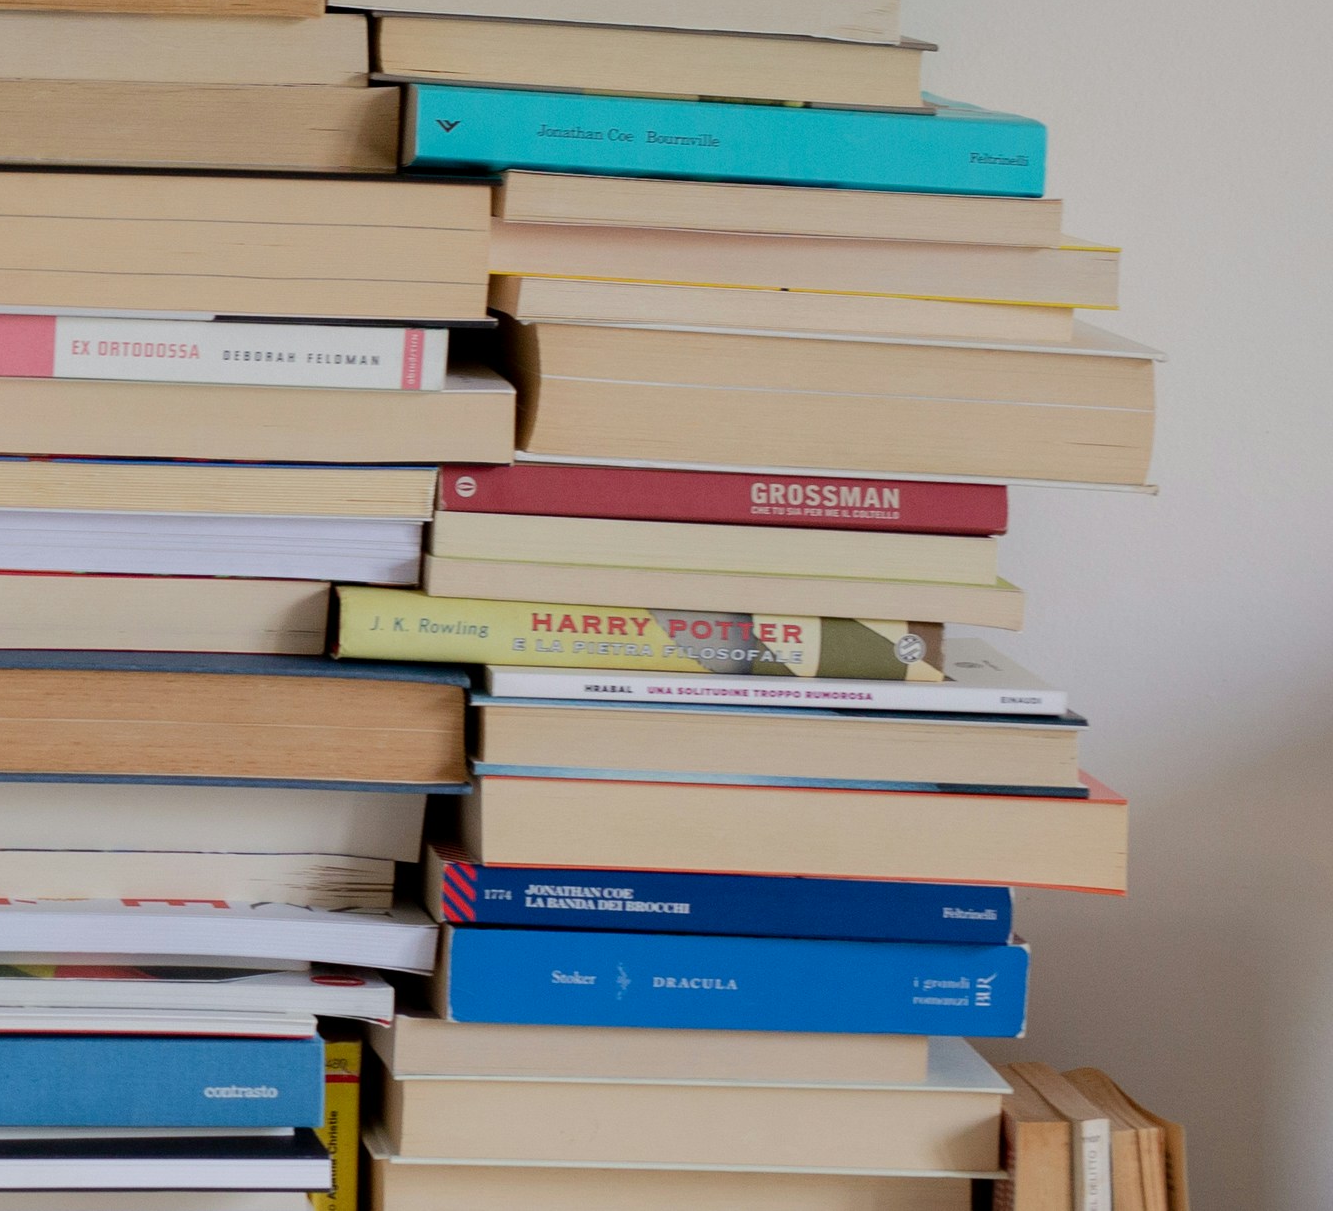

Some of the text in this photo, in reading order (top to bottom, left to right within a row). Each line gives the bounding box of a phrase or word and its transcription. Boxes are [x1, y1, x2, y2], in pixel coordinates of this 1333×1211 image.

[536, 123, 634, 143] Jonathan Coe
[645, 130, 721, 149] Bournville
[969, 152, 1029, 167] Feltrinelli
[71, 339, 200, 361] EX ORTODOSSA
[223, 349, 382, 367] DEBORAH FELDMAN
[750, 482, 901, 509] GROSSMAN
[750, 506, 771, 515] CHE
[772, 507, 785, 516] TU
[786, 507, 803, 516] SIA
[804, 508, 823, 517] PER
[825, 509, 840, 518] ME
[852, 510, 901, 520] COLTELLO
[369, 616, 489, 639] J. K. Rowling
[531, 612, 803, 644] HARRY POTTER
[511, 637, 803, 664] E LA PIETRA FILOSOFALE
[584, 684, 633, 695] HRABAL
[646, 685, 874, 702] UNA SOLITUDINE TROPPO RUMOROSA
[1000, 696, 1043, 705] EINAUDI
[483, 889, 513, 901] 1774
[524, 884, 634, 900] JONATHAN COE
[524, 896, 691, 915] LA BANDA DEI BROCCHI
[941, 907, 998, 921] Feltrinelli
[551, 969, 598, 985] Stoker
[652, 976, 738, 991] DRACULA
[922, 976, 971, 992] grandi
[974, 972, 998, 1007] BUR
[913, 994, 970, 1007] romanzi
[203, 1084, 279, 1099] contrasto
[328, 1110, 339, 1155] Christie
